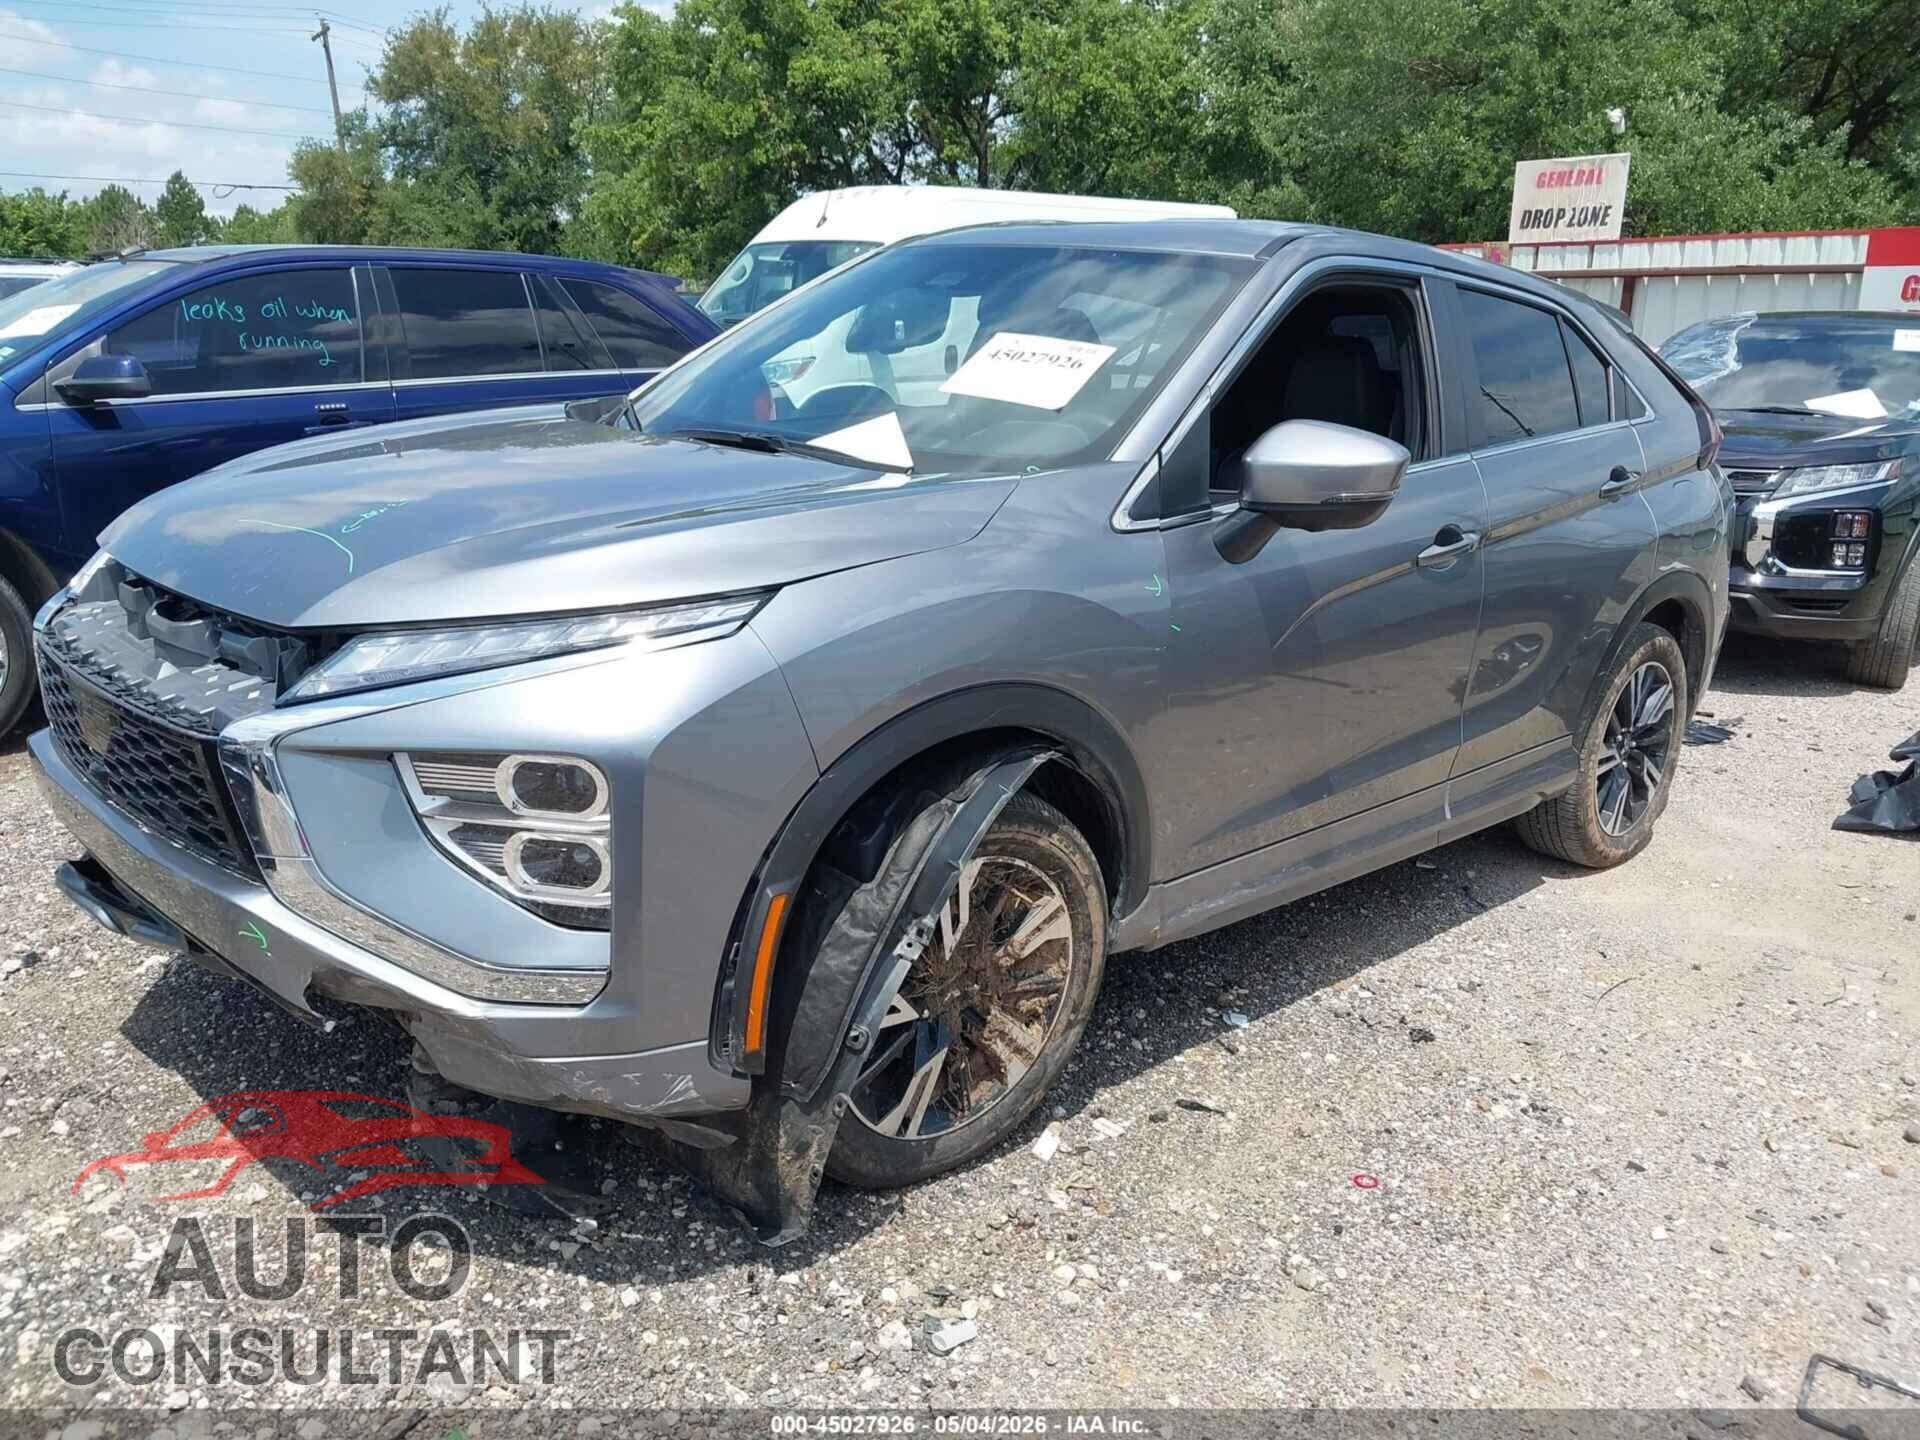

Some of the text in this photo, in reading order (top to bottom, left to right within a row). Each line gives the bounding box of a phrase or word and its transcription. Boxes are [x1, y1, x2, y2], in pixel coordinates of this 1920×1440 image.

[1537, 168, 1604, 189] GENERAL
[1519, 205, 1612, 230] DROP ZONE
[260, 297, 287, 318] oil
[295, 299, 353, 325] when
[239, 332, 338, 366] running
[988, 347, 1083, 370] 45027926
